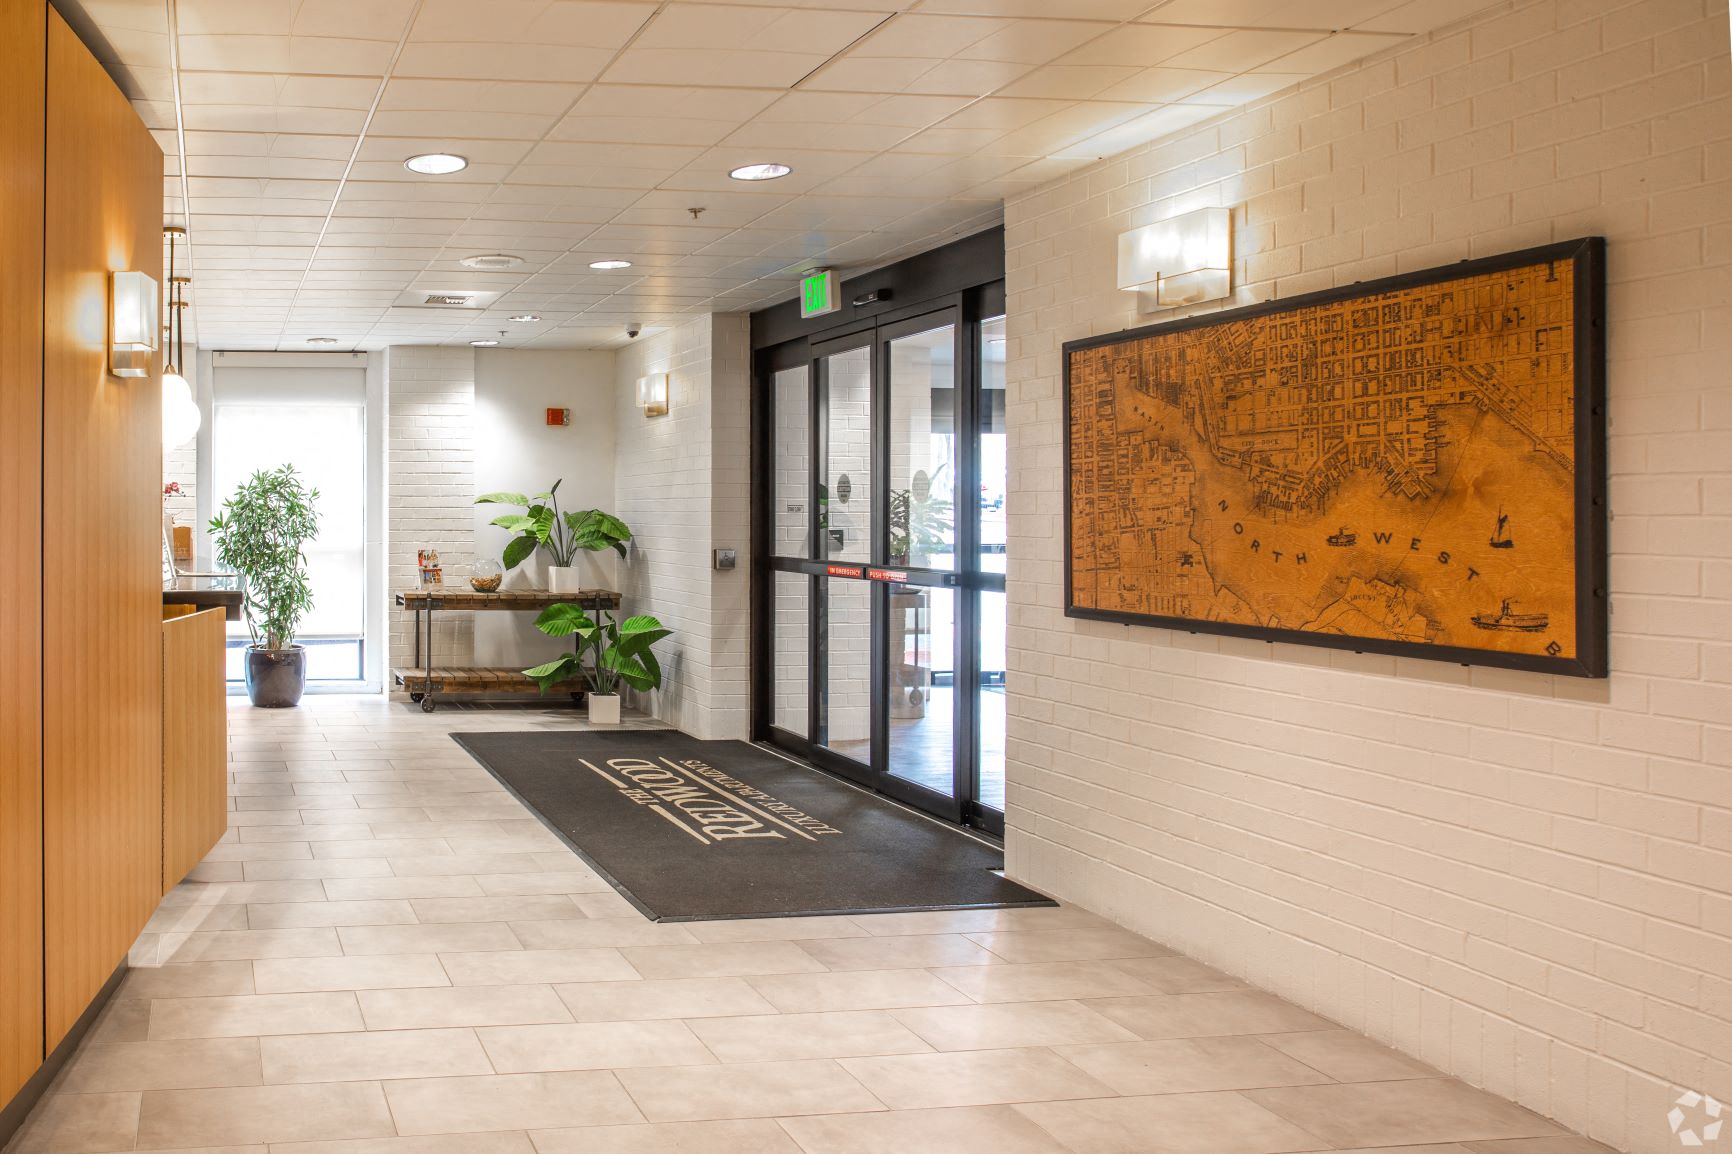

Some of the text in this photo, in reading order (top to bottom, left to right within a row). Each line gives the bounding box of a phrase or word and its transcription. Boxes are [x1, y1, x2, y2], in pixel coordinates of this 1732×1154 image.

[804, 272, 826, 313] EXIT
[1217, 499, 1308, 565] NORTH
[1373, 531, 1480, 582] WEST
[835, 568, 861, 578] EMERGENCY
[869, 571, 882, 580] PUSH
[606, 758, 787, 841] REDWOOD
[618, 788, 660, 805] THE
[680, 759, 843, 834] LUXURY APARTMENTS
